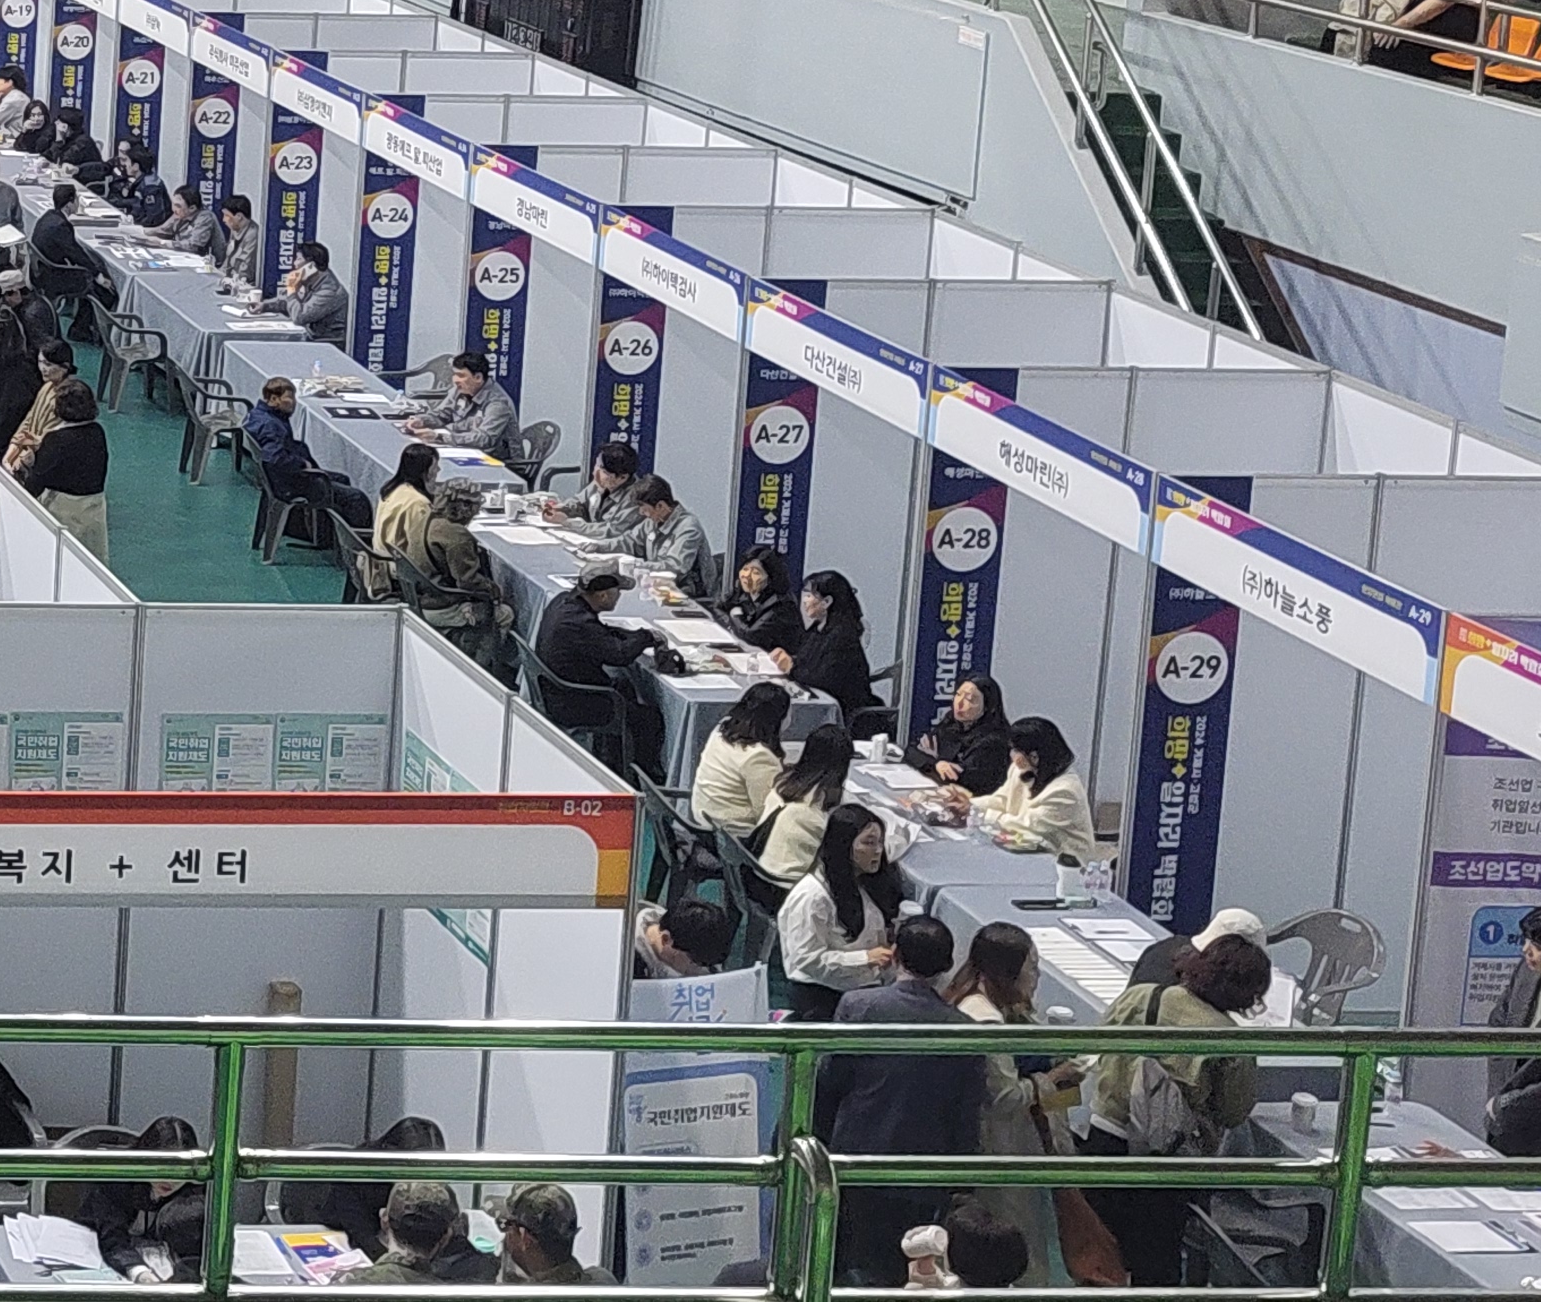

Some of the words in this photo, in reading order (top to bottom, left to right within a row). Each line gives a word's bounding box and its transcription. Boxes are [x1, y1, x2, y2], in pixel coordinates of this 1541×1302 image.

[4, 3, 33, 17] A-19
[59, 34, 90, 48] A-20
[125, 71, 155, 85] A-21
[197, 110, 231, 126] A-22
[278, 155, 314, 171] A-23
[371, 207, 409, 223] A-24
[516, 197, 549, 230] 경남마린
[478, 266, 521, 285] A-25
[608, 339, 653, 358] A-26
[803, 343, 863, 394] 다산건설(주)
[754, 424, 804, 445] A-27
[999, 439, 1070, 499] 해성마린(주)
[936, 528, 991, 551] A-28
[1241, 564, 1334, 636] (주)하늘소풍
[1407, 604, 1433, 627] A-29
[1161, 655, 1222, 680] A-29
[562, 800, 603, 817] B-02
[1156, 781, 1186, 849] 일자리
[167, 846, 250, 886] 센터
[1150, 854, 1180, 922] 박람회
[668, 982, 715, 1020] 취업
[646, 1100, 753, 1127] 국민취업지원제도
